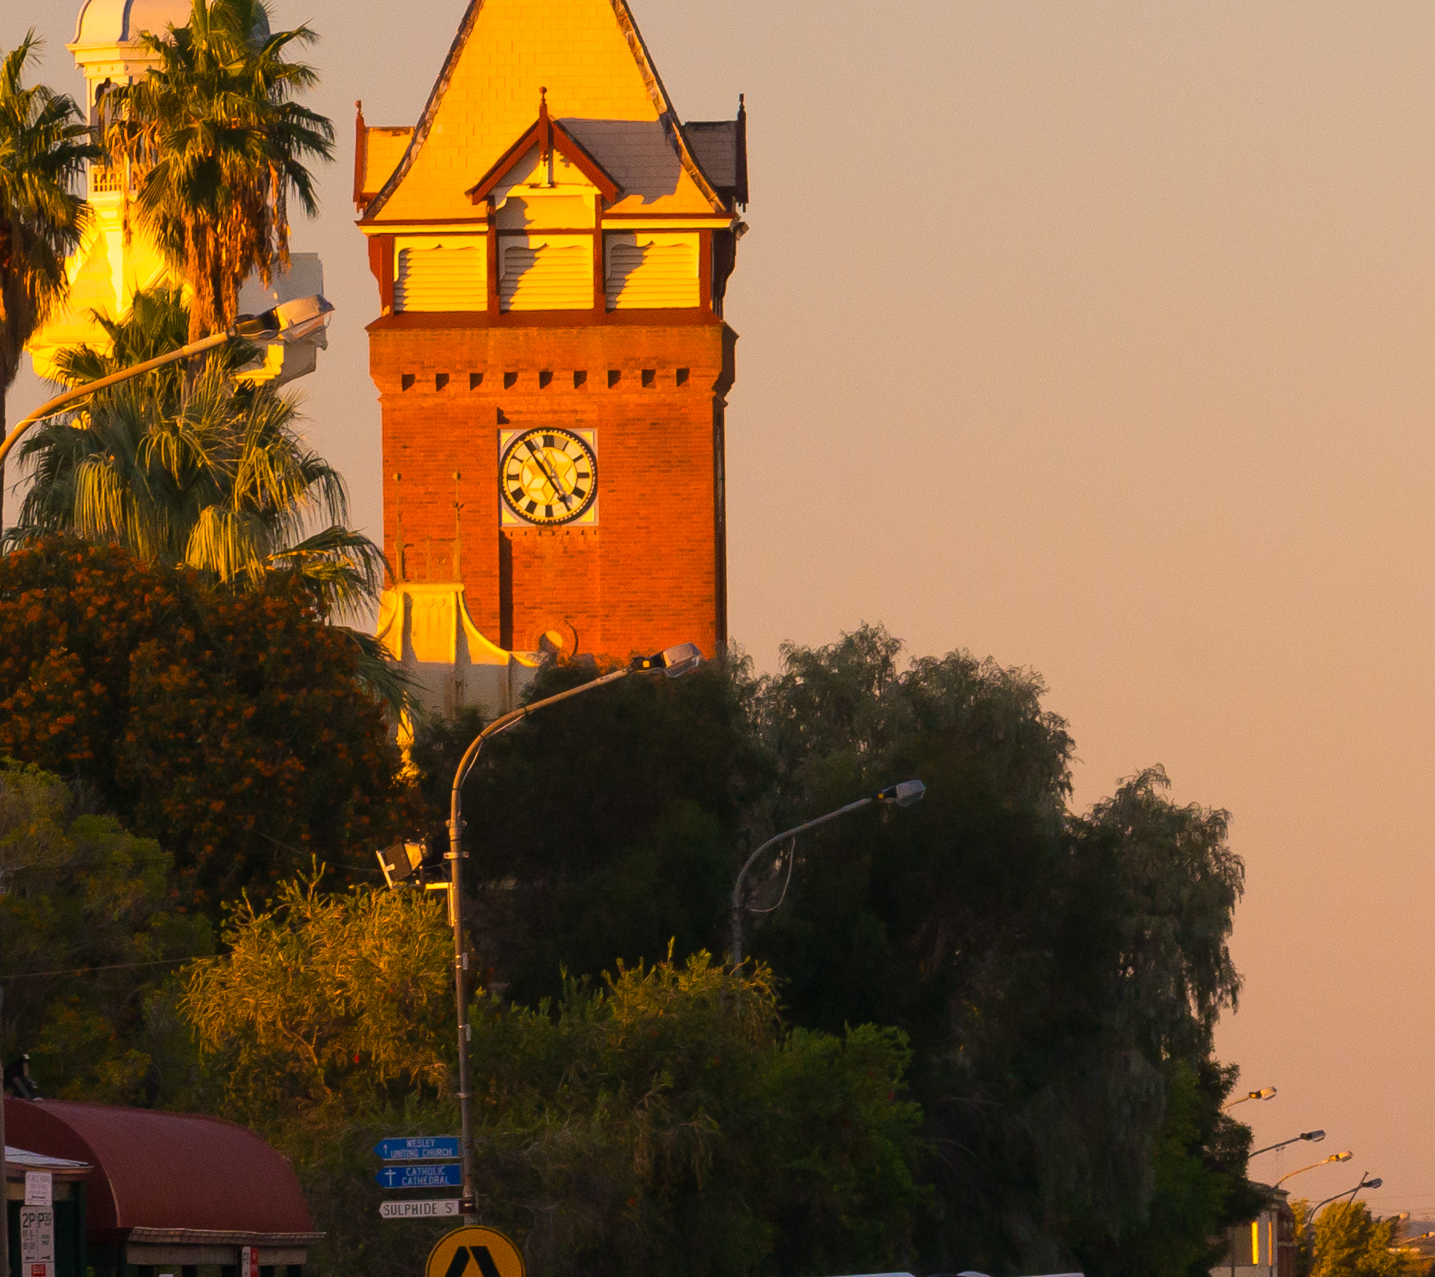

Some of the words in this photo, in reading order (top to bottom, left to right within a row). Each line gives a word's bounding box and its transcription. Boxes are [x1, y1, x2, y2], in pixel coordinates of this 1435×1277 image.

[406, 1139, 435, 1148] WESLEY
[422, 1148, 453, 1157] CHURCH
[405, 1166, 446, 1176] CATHOLIC
[402, 1176, 449, 1186] CATHEDRAL
[383, 1202, 438, 1216] SULPHIDE
